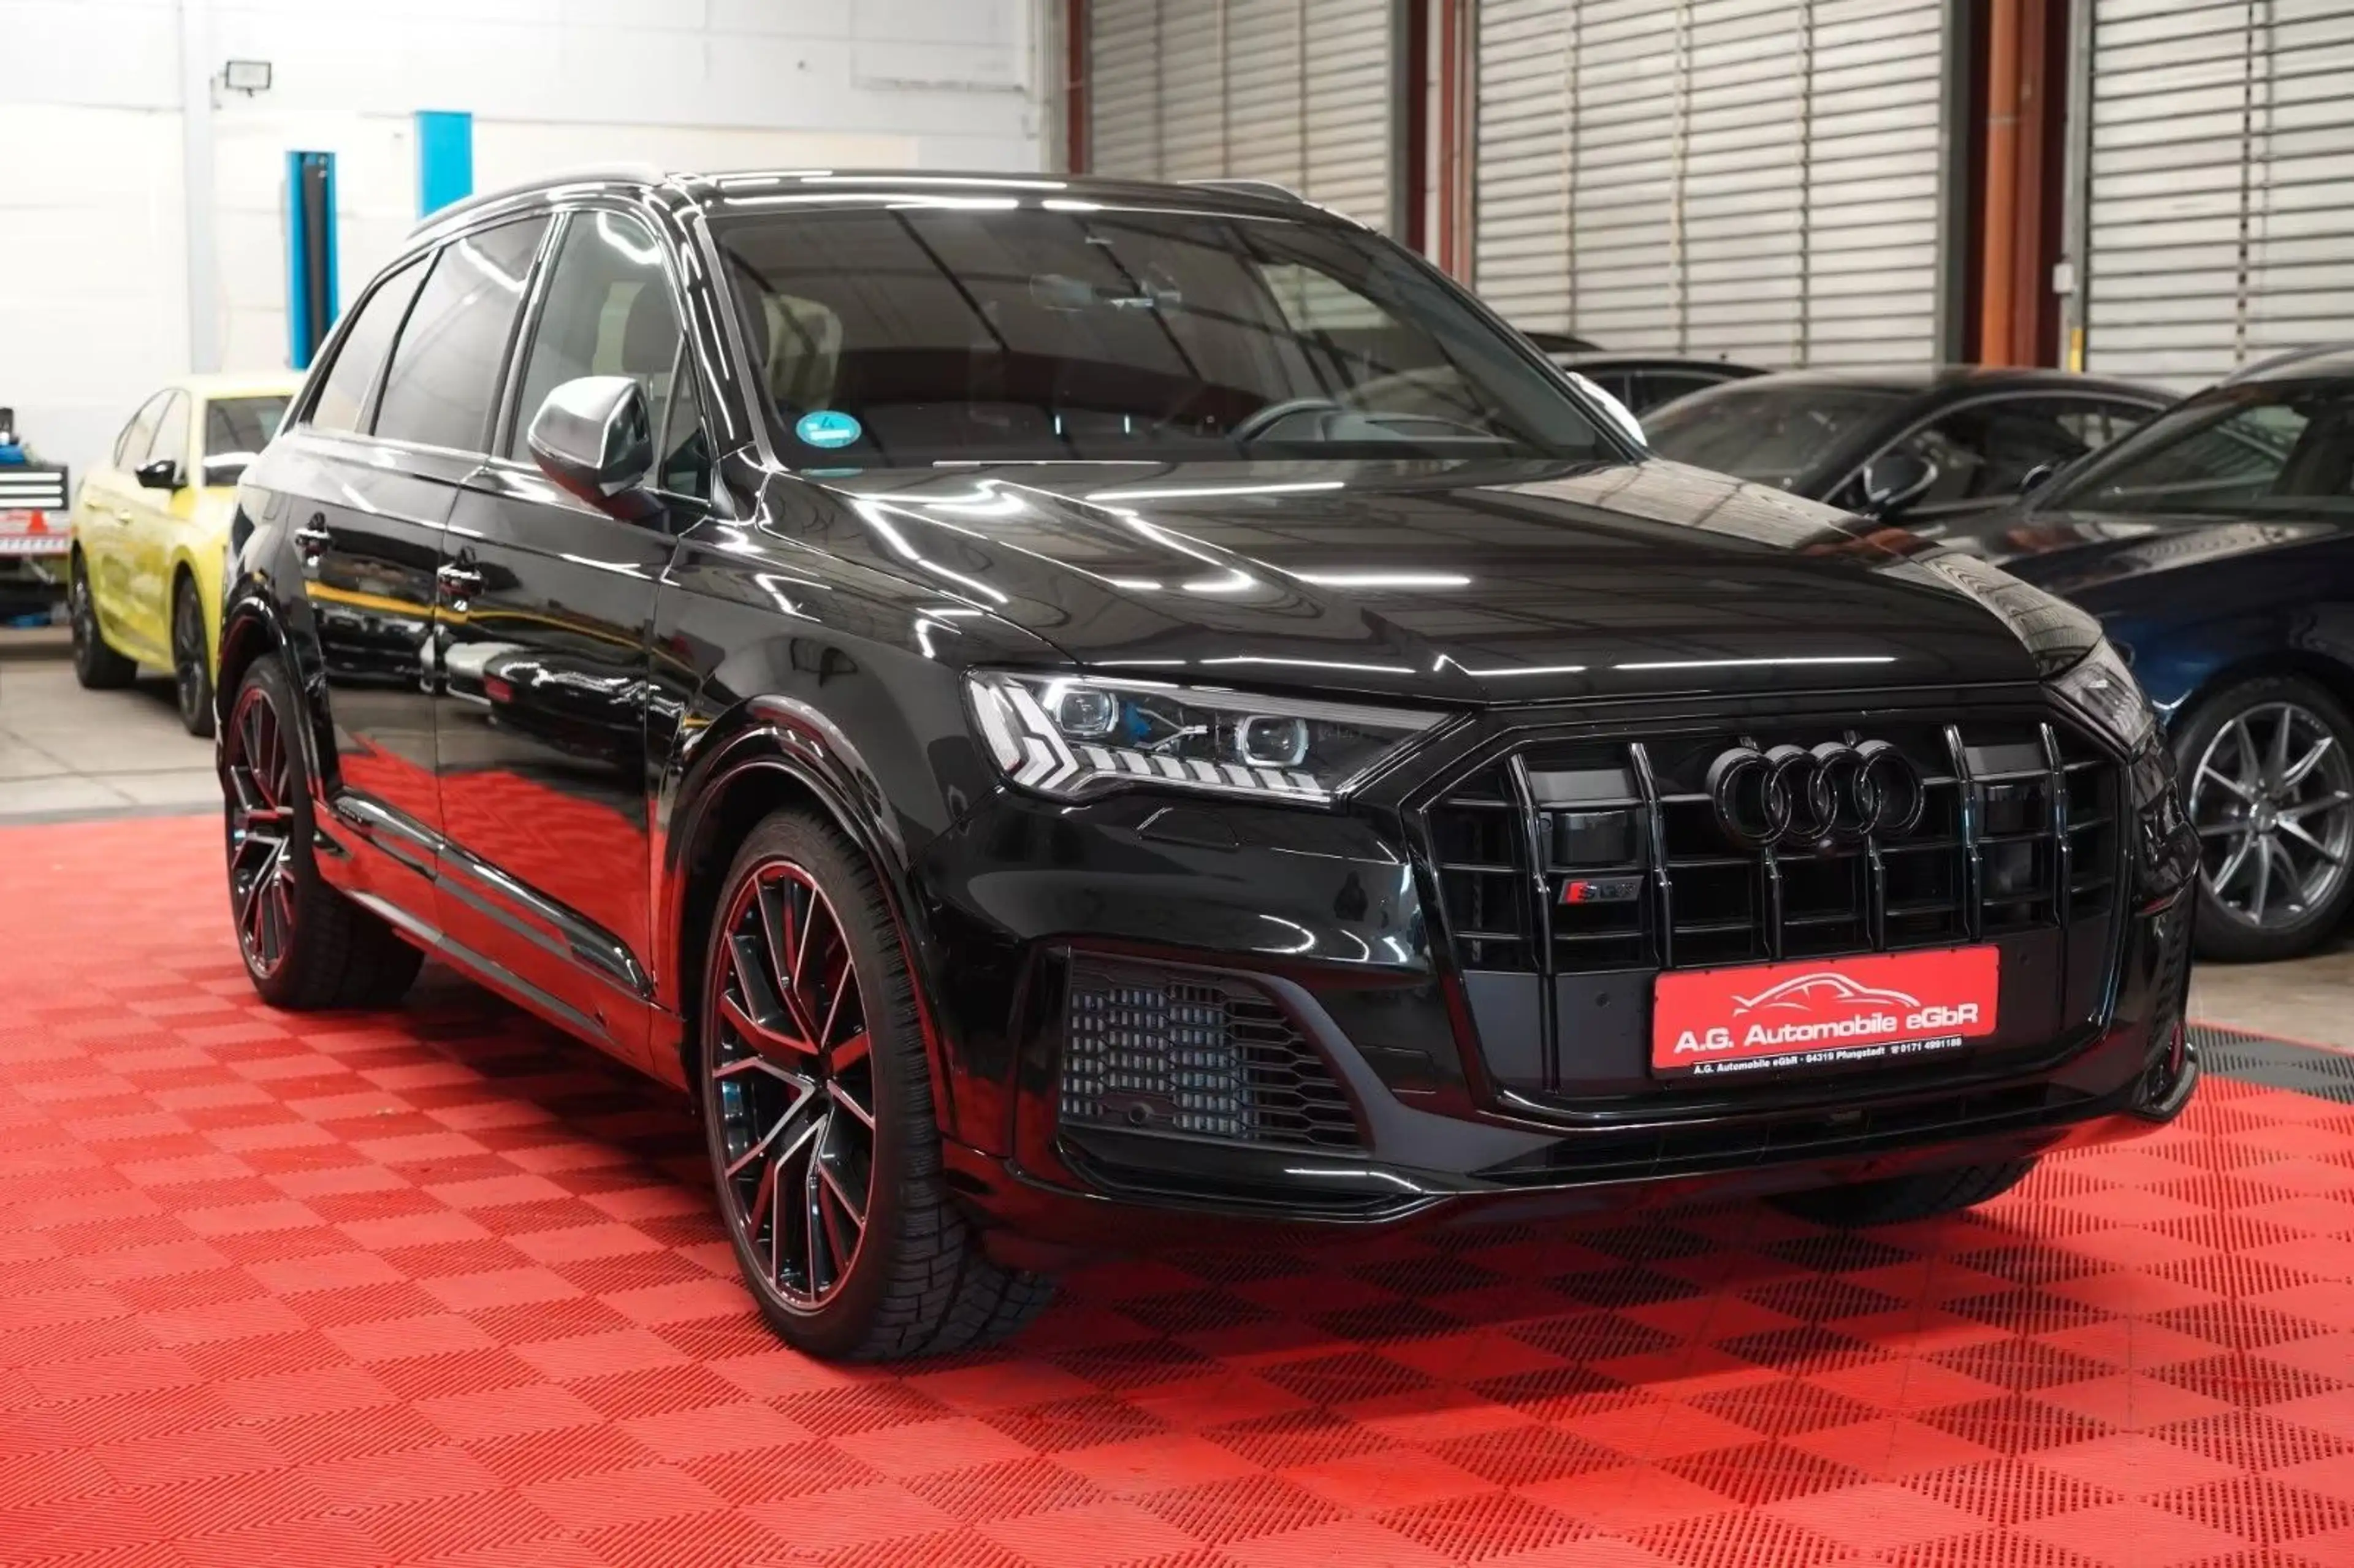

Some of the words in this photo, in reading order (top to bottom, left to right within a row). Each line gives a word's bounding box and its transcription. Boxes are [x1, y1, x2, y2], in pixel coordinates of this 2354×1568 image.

[1674, 1027, 1735, 1054] A.G.
[1743, 1011, 1898, 1047] Automobile
[1906, 1003, 1979, 1030] eGbR
[1693, 1064, 1714, 1075] A.G.
[1716, 1059, 1771, 1073] Automobile
[1772, 1056, 1798, 1067] eGbR
[1836, 1045, 1886, 1060] Pfungstadt
[1900, 1041, 1922, 1053] 0171
